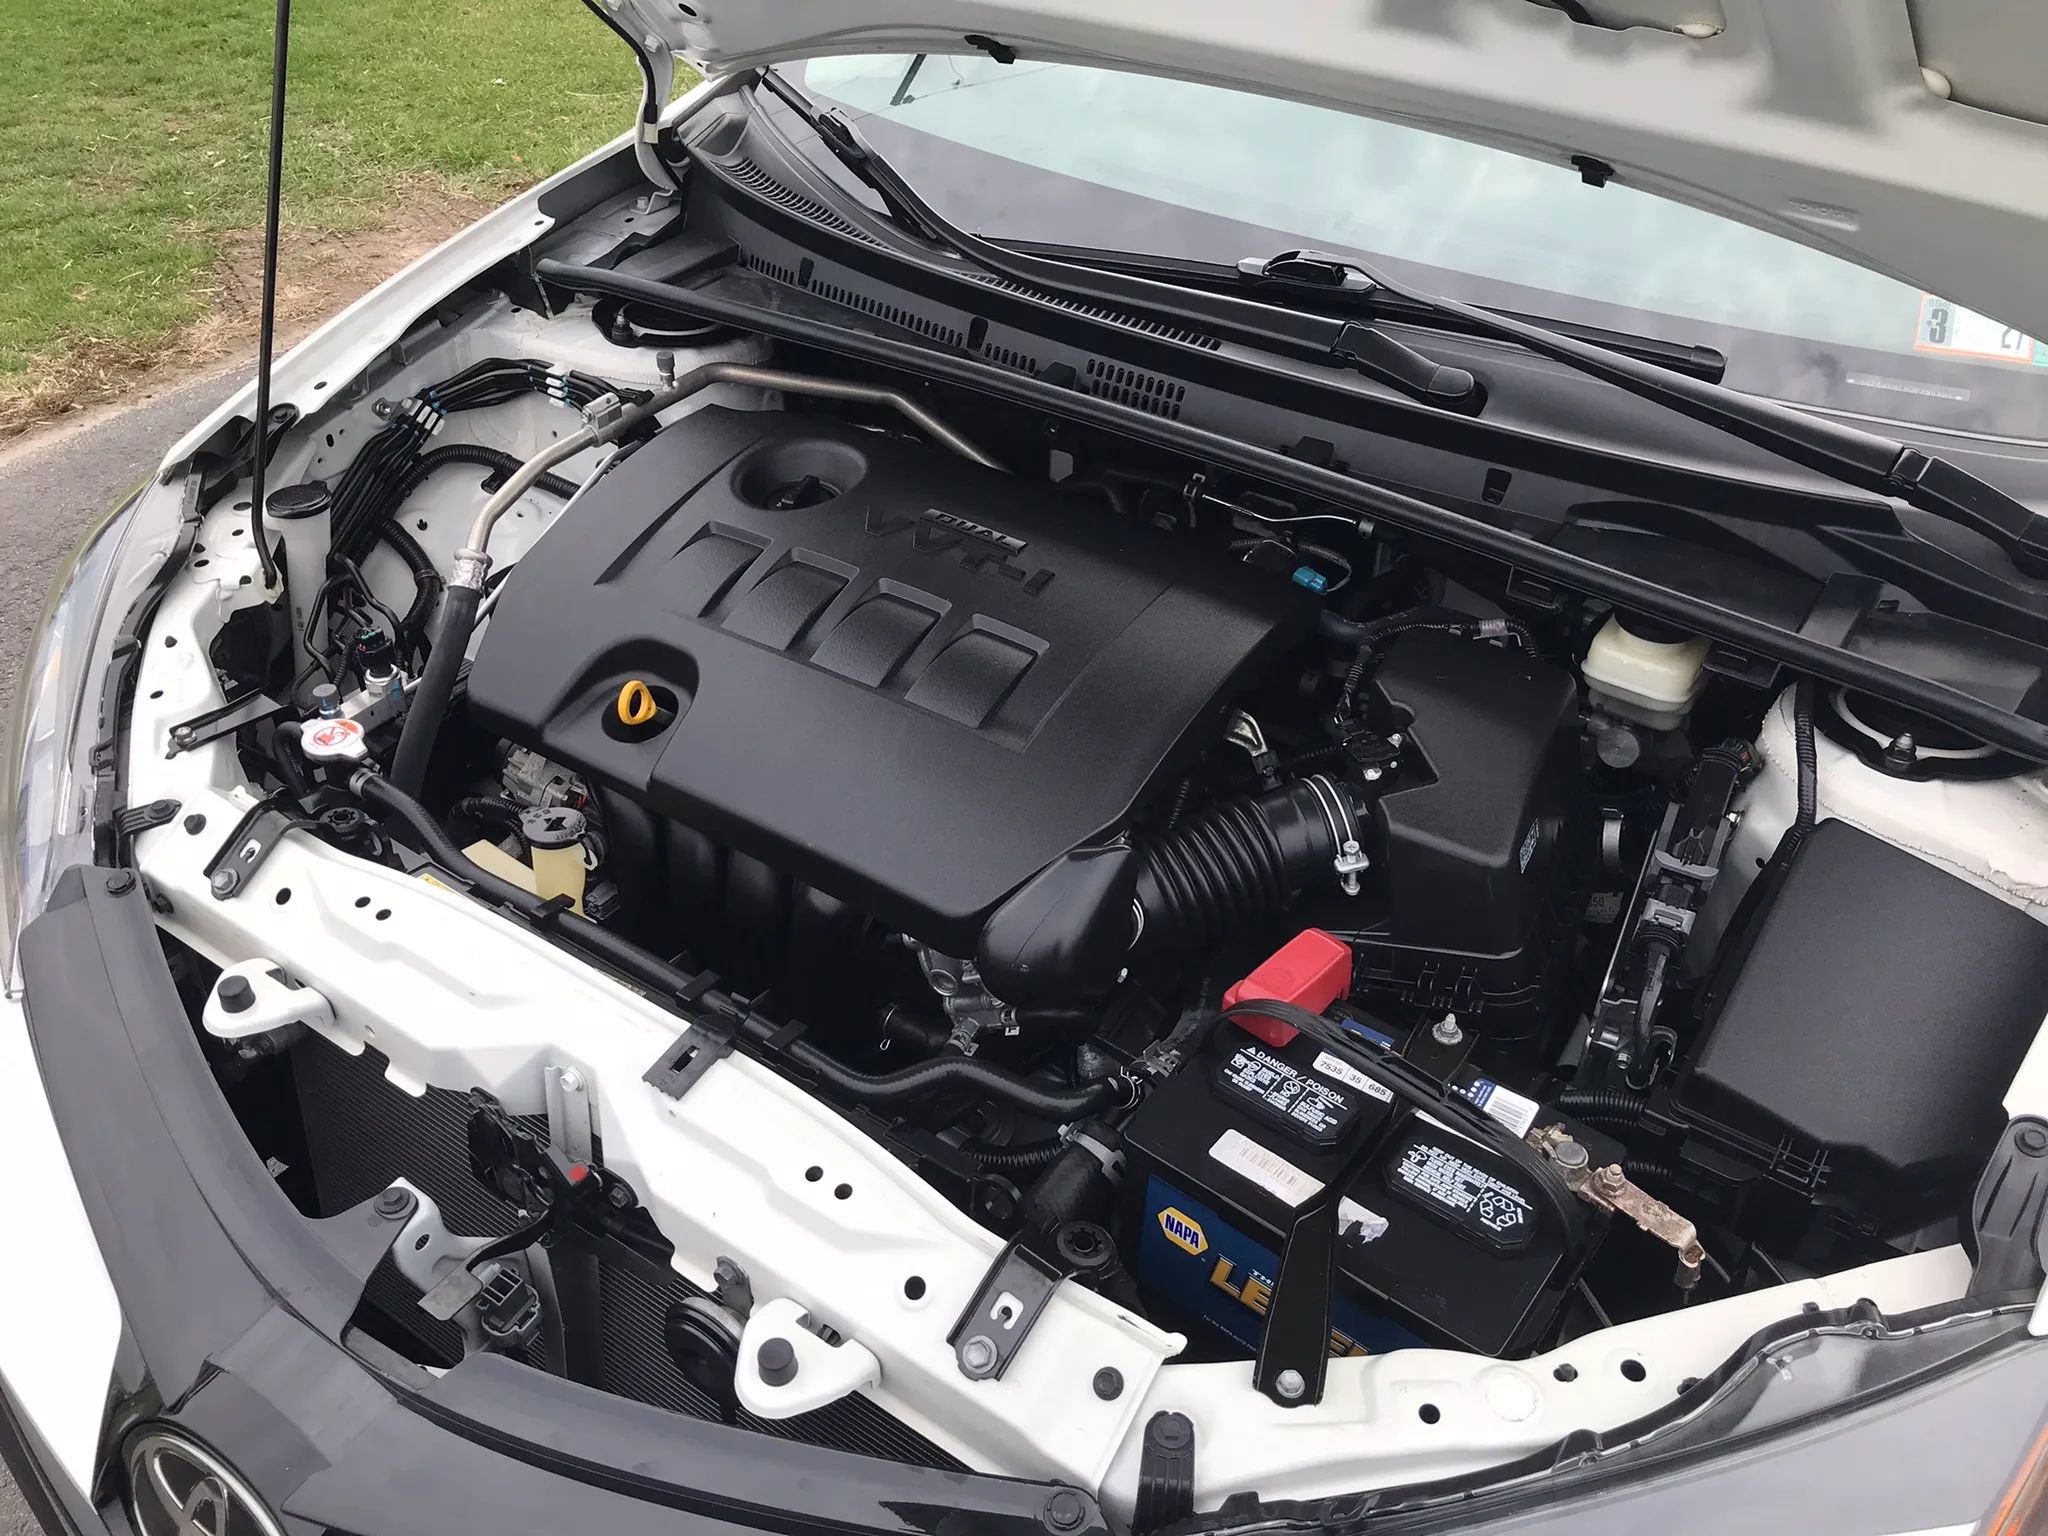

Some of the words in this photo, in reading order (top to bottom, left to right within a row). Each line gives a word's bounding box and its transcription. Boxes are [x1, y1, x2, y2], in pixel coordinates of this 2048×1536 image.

[1928, 308, 1949, 344] 3
[935, 513, 1013, 547] DUAL
[1255, 1051, 1298, 1077] DANGER
[1304, 1078, 1344, 1103] POISON
[1319, 1060, 1343, 1076] 7535
[1348, 1073, 1362, 1085] 35
[1368, 1082, 1388, 1097] 685
[1164, 1213, 1200, 1249] NAPA
